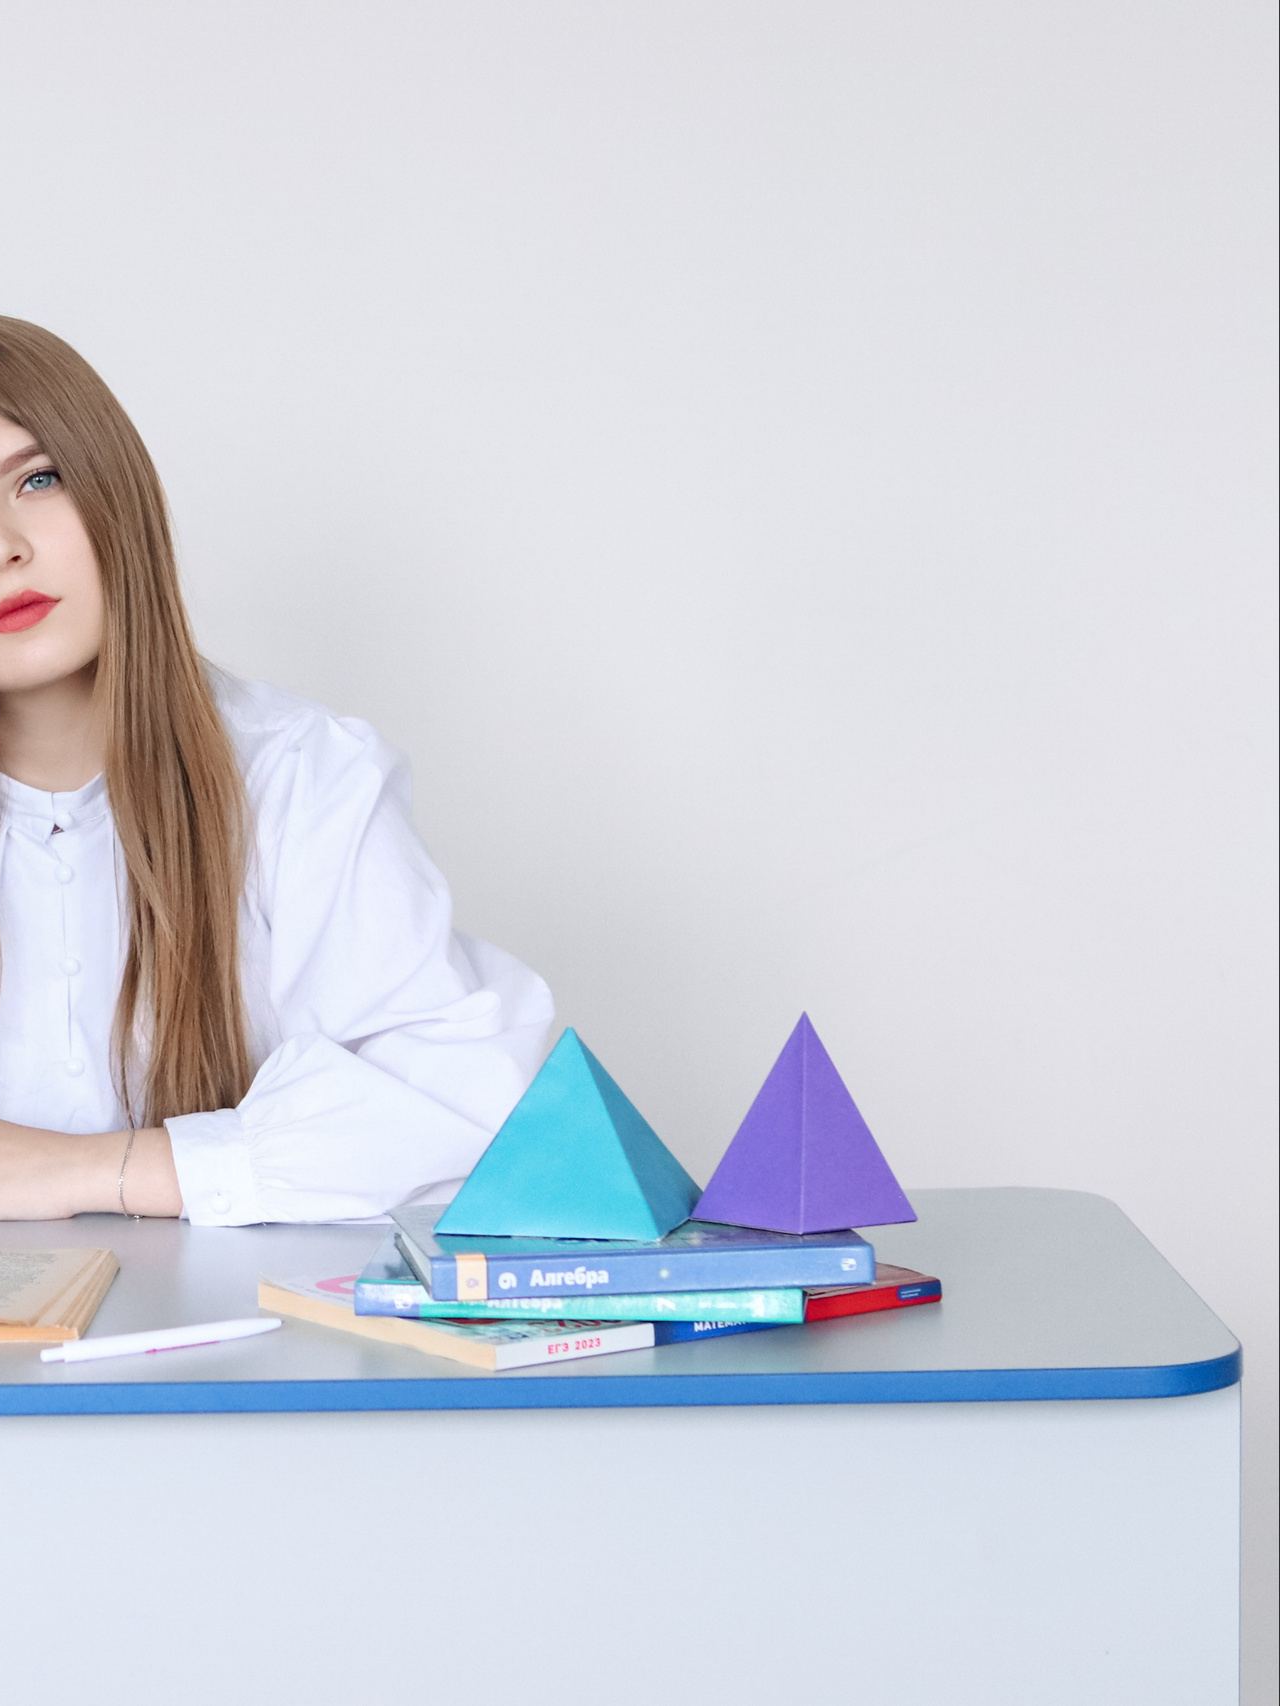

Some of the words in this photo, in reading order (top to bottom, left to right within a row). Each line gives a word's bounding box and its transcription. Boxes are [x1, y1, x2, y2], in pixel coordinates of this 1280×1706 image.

[529, 1266, 609, 1289] Алгебра
[547, 1344, 569, 1355] ЕГЭ
[575, 1338, 601, 1350] 2023
